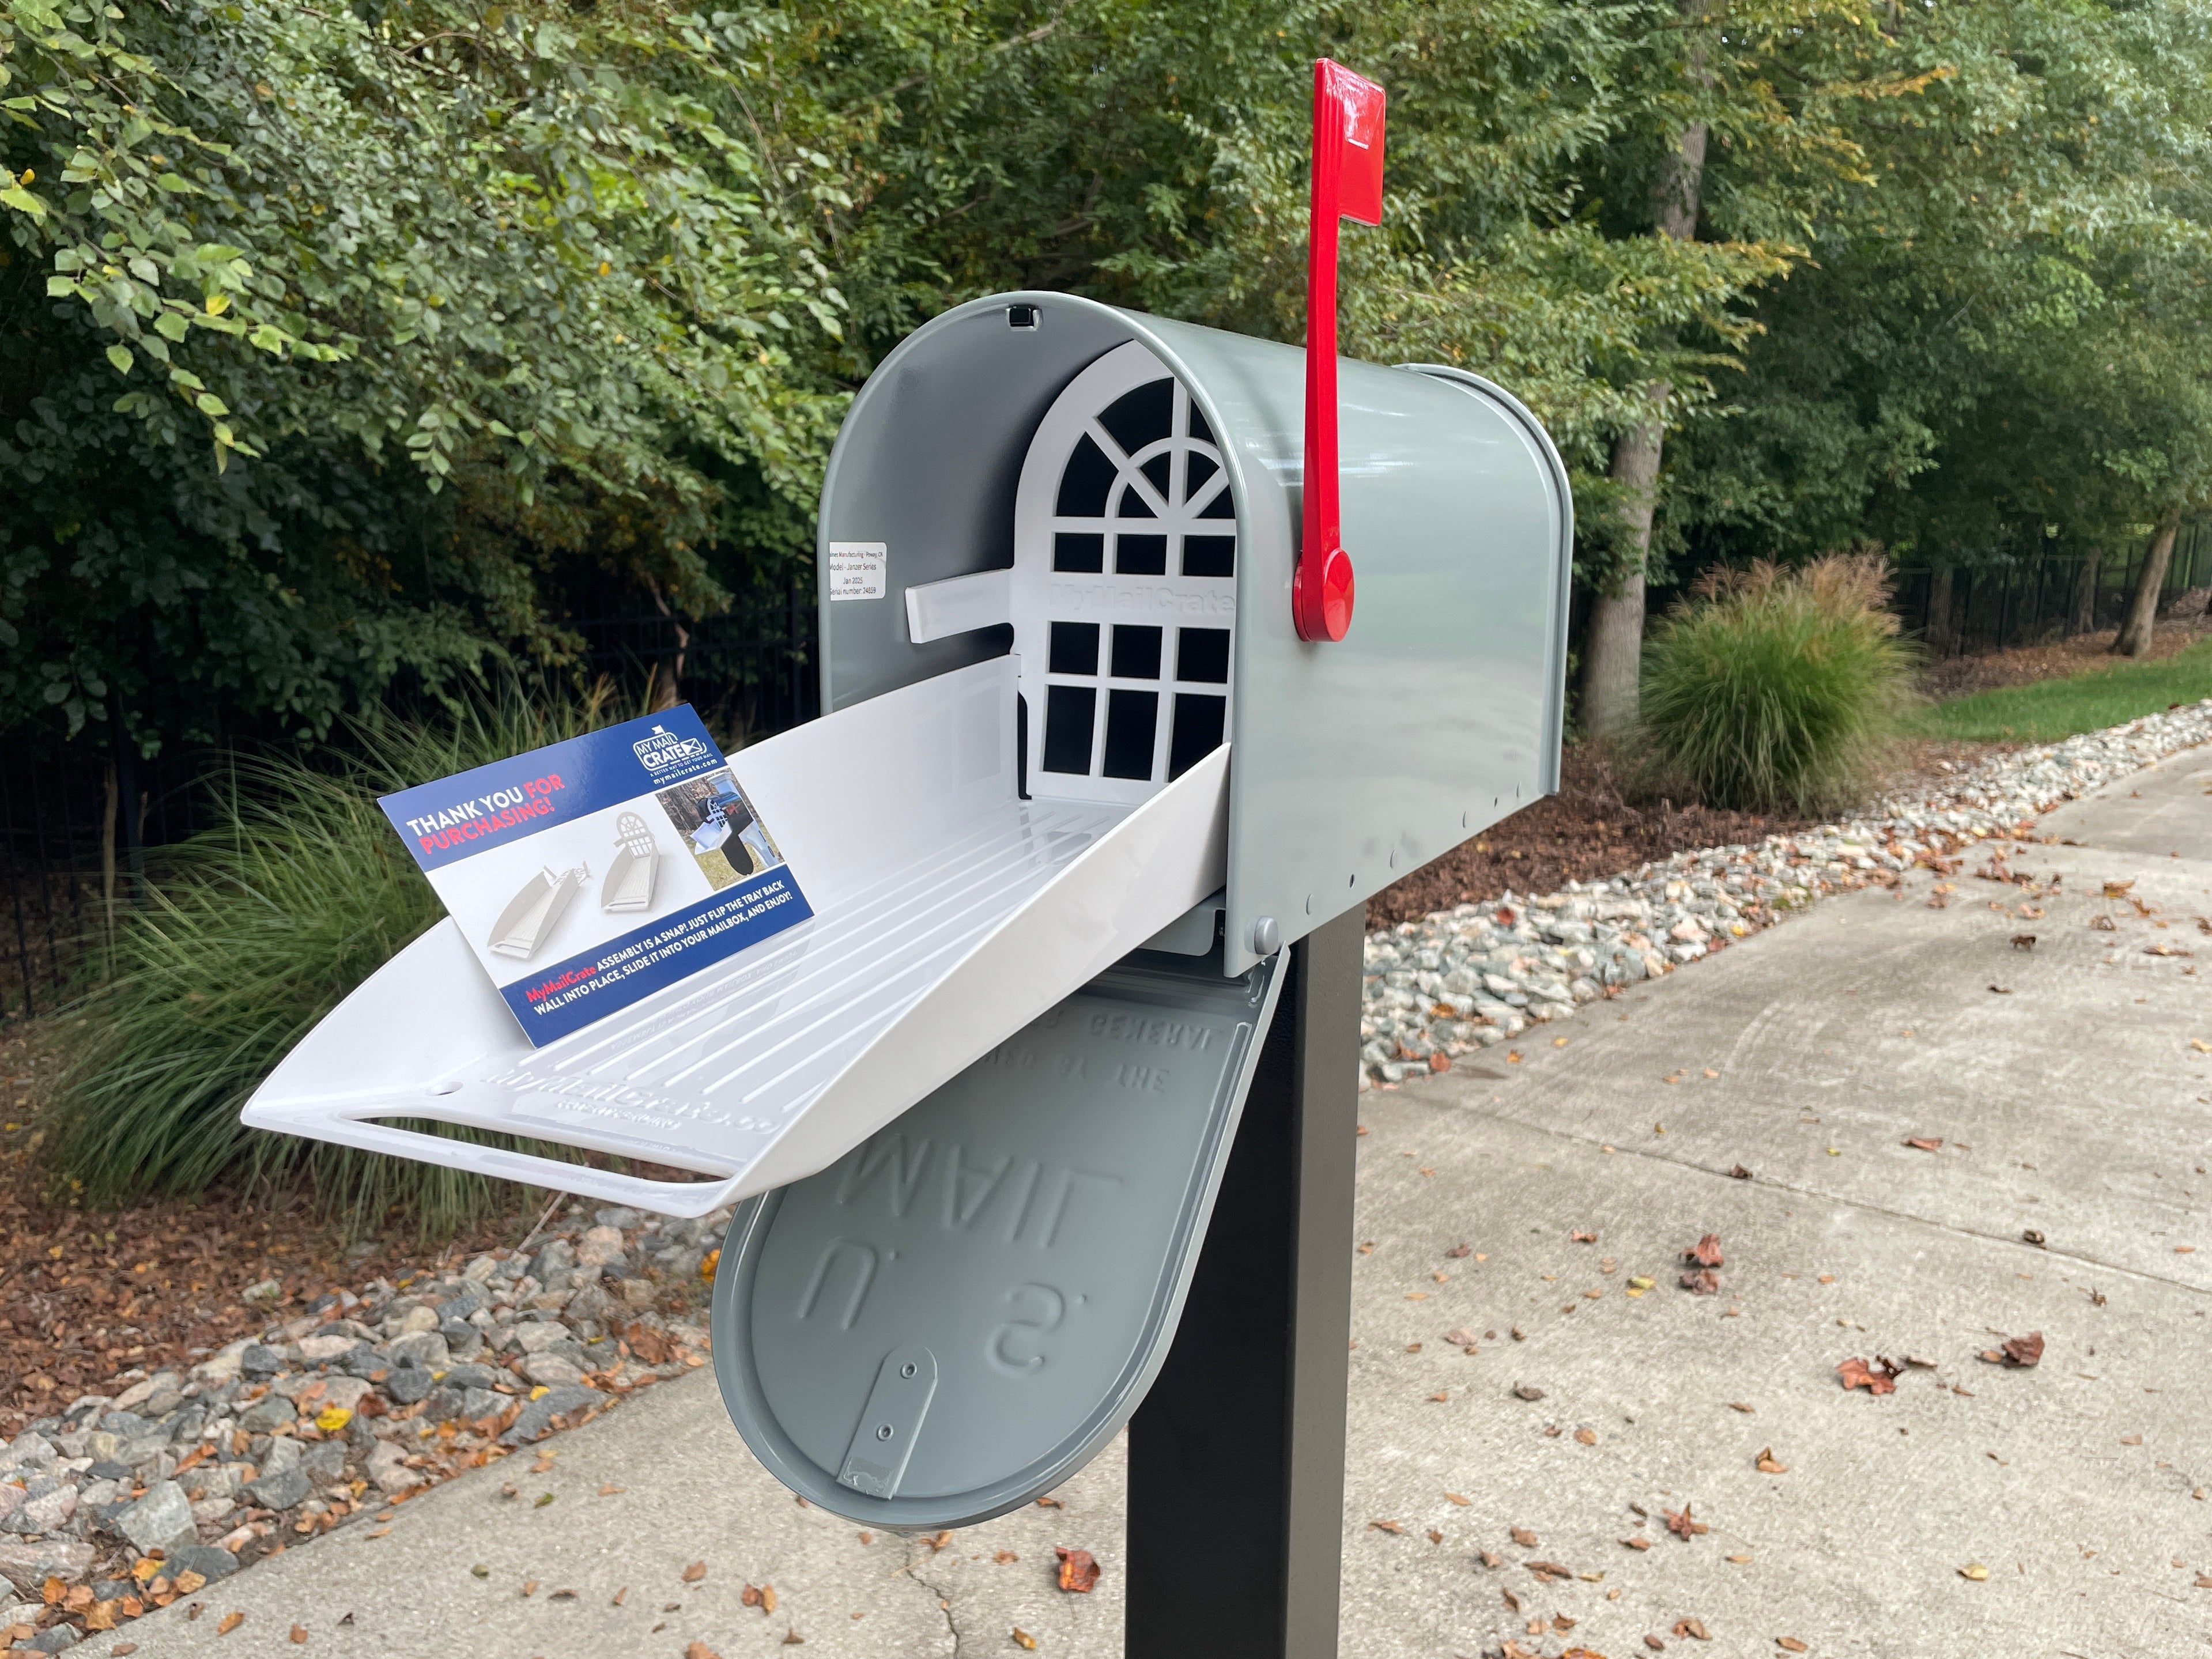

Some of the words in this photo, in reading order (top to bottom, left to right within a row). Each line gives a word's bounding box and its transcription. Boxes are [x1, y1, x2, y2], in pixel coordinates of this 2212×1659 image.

[830, 562, 844, 571] Model
[863, 562, 877, 570] Series
[830, 587, 842, 595] Serial
[852, 576, 863, 584] 2025
[1050, 584, 1236, 613] MyMailCrate
[636, 741, 652, 755] MY
[652, 735, 678, 750] MAIL
[643, 744, 685, 768] CRATE
[653, 758, 718, 785] mymailcrate.com
[654, 768, 669, 776] BETTER
[406, 800, 483, 837] THANK
[478, 787, 523, 812] YOU
[523, 774, 565, 799] FOR
[418, 797, 555, 855] PURCHASING!
[525, 966, 597, 1003] MyMailCrate
[597, 942, 644, 973] ASSEMBLY
[643, 938, 655, 950] IS
[655, 935, 663, 946] A
[660, 923, 689, 942] SNAP!
[688, 913, 708, 930] JUST
[705, 906, 726, 921] FLIP
[724, 898, 744, 913] THE
[741, 889, 764, 905] TRAY
[761, 879, 785, 897] BACK
[534, 996, 565, 1016] WALL
[564, 984, 590, 1003] INTO
[588, 969, 625, 991] PLACE,
[622, 956, 651, 976] SLIDE
[649, 951, 660, 963] IT
[659, 942, 682, 959] INTO
[681, 930, 708, 948] YOUR
[707, 912, 749, 938] MAILBOX,
[748, 903, 767, 919] AND
[766, 891, 793, 909] ENJOY!
